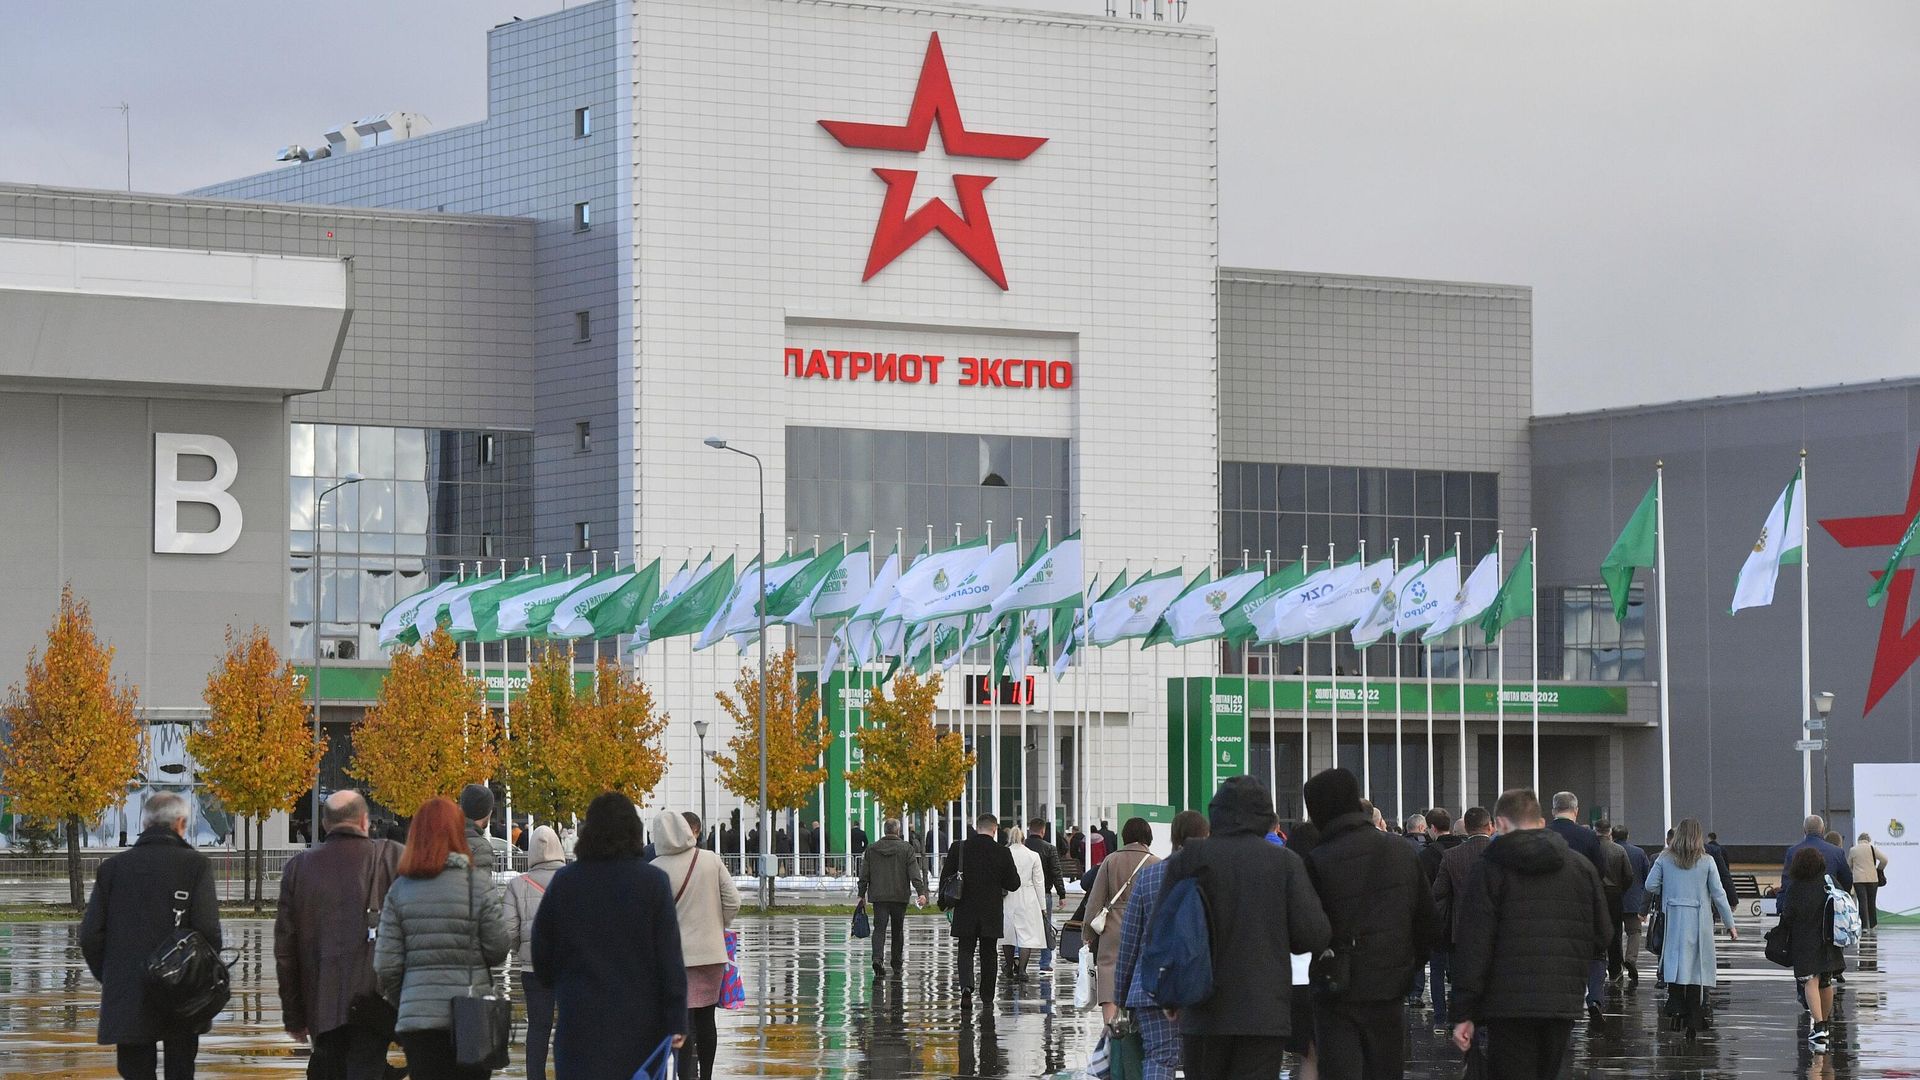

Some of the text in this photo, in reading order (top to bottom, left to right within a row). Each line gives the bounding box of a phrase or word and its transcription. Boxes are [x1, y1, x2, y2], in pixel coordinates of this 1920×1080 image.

[784, 347, 1072, 389] ПАТРИОТ ЭКСПО
[486, 676, 504, 689] ОСЕН
[508, 677, 528, 689] 202
[1210, 694, 1243, 704] ЗЛОТАЯ 20
[1315, 688, 1339, 699] ЗОЛОТЯ
[1357, 689, 1379, 700] 222
[1497, 691, 1520, 702] ЛОТАЯ
[1537, 692, 1559, 703] 2022
[1233, 704, 1243, 713] 22
